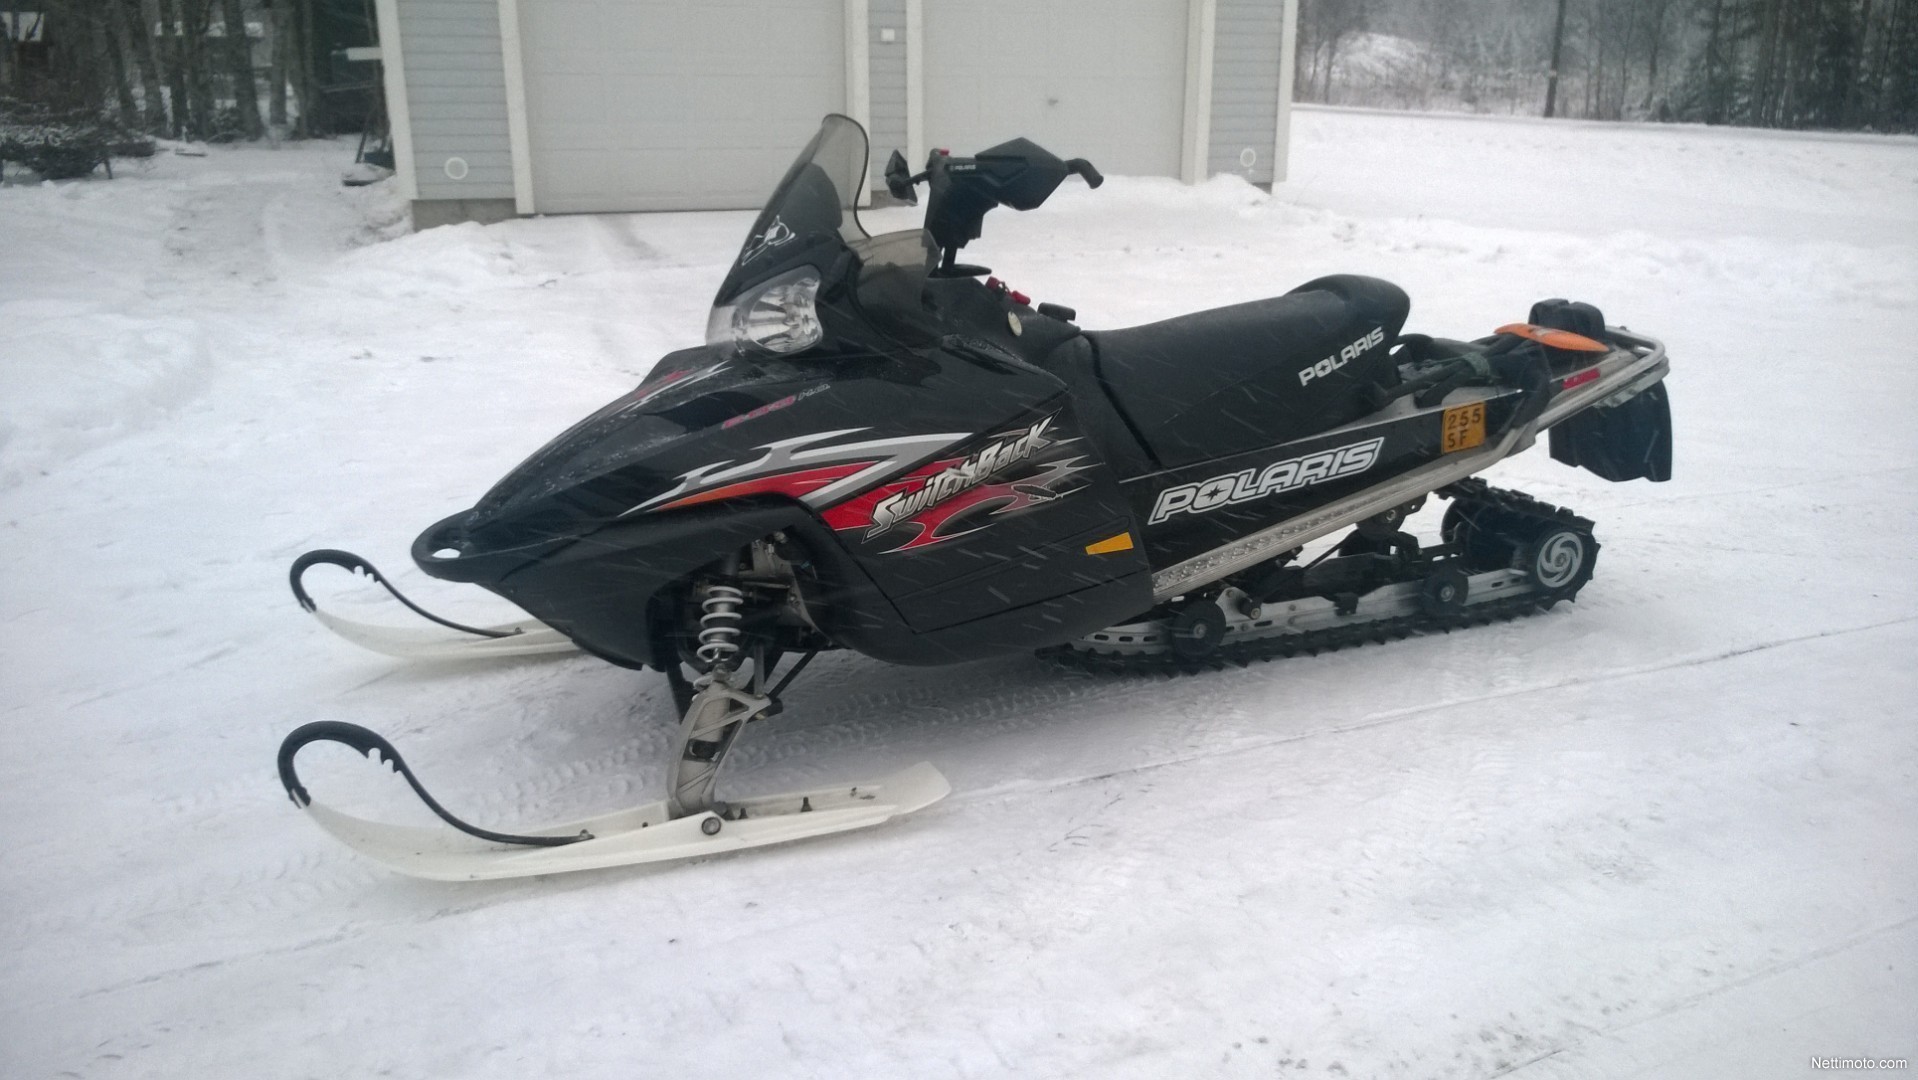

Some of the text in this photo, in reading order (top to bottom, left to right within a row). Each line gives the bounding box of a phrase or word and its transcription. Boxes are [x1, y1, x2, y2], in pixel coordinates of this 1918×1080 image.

[1298, 326, 1385, 387] POLARIS
[1447, 407, 1481, 430] 255
[1447, 429, 1468, 448] SF
[1148, 437, 1384, 525] POLARIS
